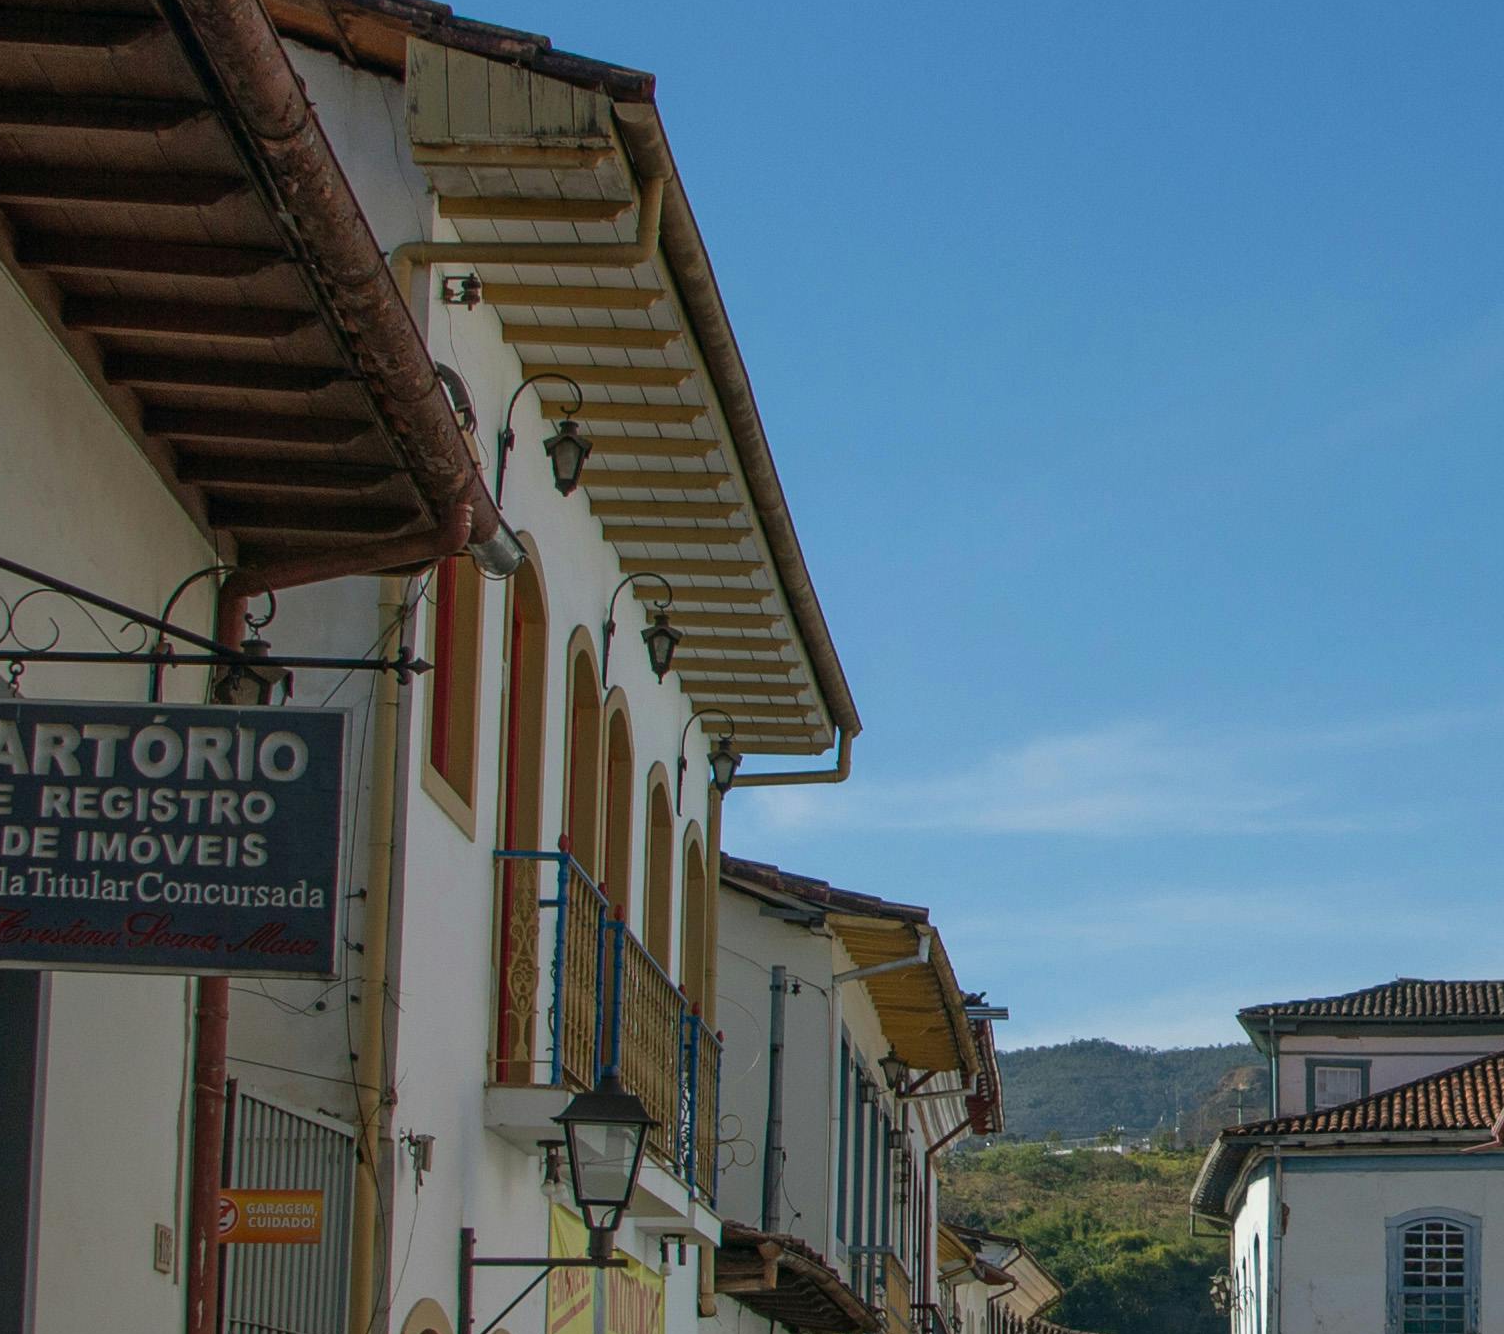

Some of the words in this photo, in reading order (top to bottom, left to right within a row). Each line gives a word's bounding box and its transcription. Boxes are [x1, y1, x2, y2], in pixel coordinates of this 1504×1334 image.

[39, 784, 277, 825] REGISTRO
[1, 824, 61, 859] DE
[74, 827, 270, 868] IMÓVEIS
[28, 866, 134, 901] Titular
[136, 871, 326, 909] Concursada
[246, 1202, 318, 1216] GARAGEM,
[248, 1217, 316, 1228] CUIDADO!
